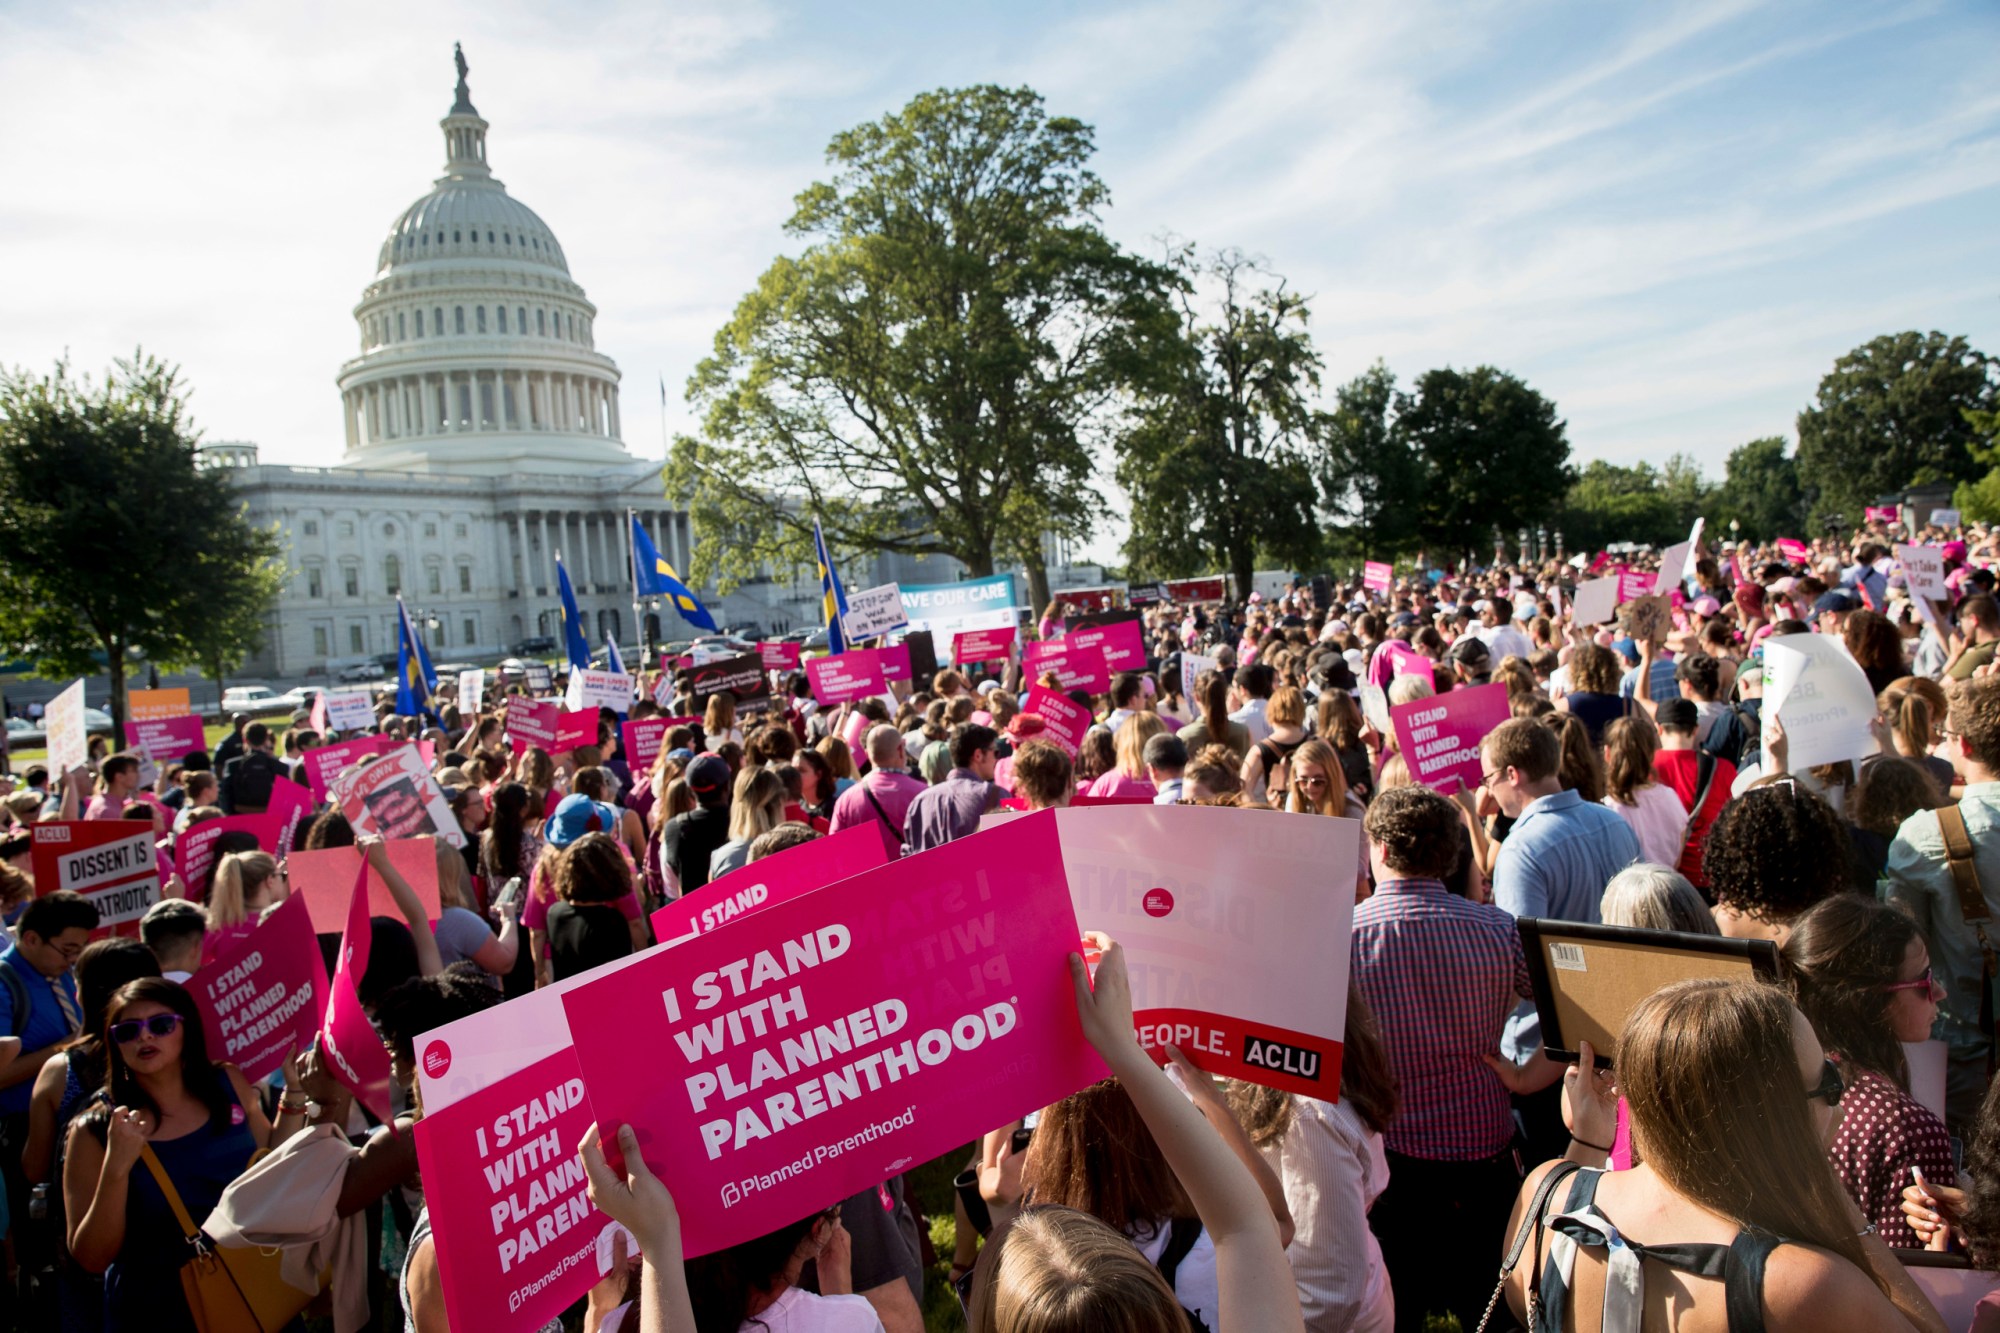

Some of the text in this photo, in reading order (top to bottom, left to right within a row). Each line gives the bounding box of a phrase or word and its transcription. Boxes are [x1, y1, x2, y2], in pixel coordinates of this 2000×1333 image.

[852, 596, 876, 613] STOP
[900, 580, 1007, 609] AVE OUR CARE
[856, 622, 869, 632] ON
[819, 669, 838, 678] WITH
[820, 660, 844, 670] STAND
[1039, 657, 1067, 669] STAND
[585, 682, 604, 690] SAVE
[606, 677, 629, 686] LIVES
[820, 674, 853, 686] PLANNED
[822, 678, 872, 693] PARENTHOOD
[1046, 697, 1077, 718] STAND
[1407, 715, 1414, 728] I
[1413, 706, 1448, 726] STAND
[508, 713, 542, 727] PLANNED
[638, 724, 665, 734] STAND
[507, 722, 555, 741] PARENTHOOD
[635, 732, 655, 741] WITH
[1411, 724, 1438, 744] WITH
[321, 748, 350, 761] STAND
[1414, 735, 1460, 760] PLANNED
[320, 758, 343, 770] WITH
[1418, 745, 1480, 775] PARENTHOO
[368, 762, 395, 784] OWN
[37, 828, 69, 841] ACLU
[190, 827, 223, 847] STAND
[69, 841, 148, 882] DISSENT IS
[186, 842, 209, 860] WITH
[91, 885, 151, 917] ATRIOTIC
[690, 883, 769, 936] I STAND
[207, 951, 263, 999] I STAND
[662, 923, 852, 1024] I STAND
[214, 979, 256, 1017] WITH
[220, 982, 286, 1037] PLANNED
[225, 982, 313, 1056] PARENTHOOD
[673, 985, 809, 1064] WITH
[684, 998, 908, 1114] PLANNED
[1246, 1040, 1317, 1078] ACLU
[699, 1000, 1017, 1161] PARENTHOOD
[475, 1077, 585, 1159] I STAND
[483, 1127, 562, 1194] WITH
[741, 1104, 917, 1198] Planned Parenthood
[490, 1152, 588, 1236] PLANN
[498, 1186, 598, 1275] PAREN
[520, 1235, 598, 1303] Planned Parent
